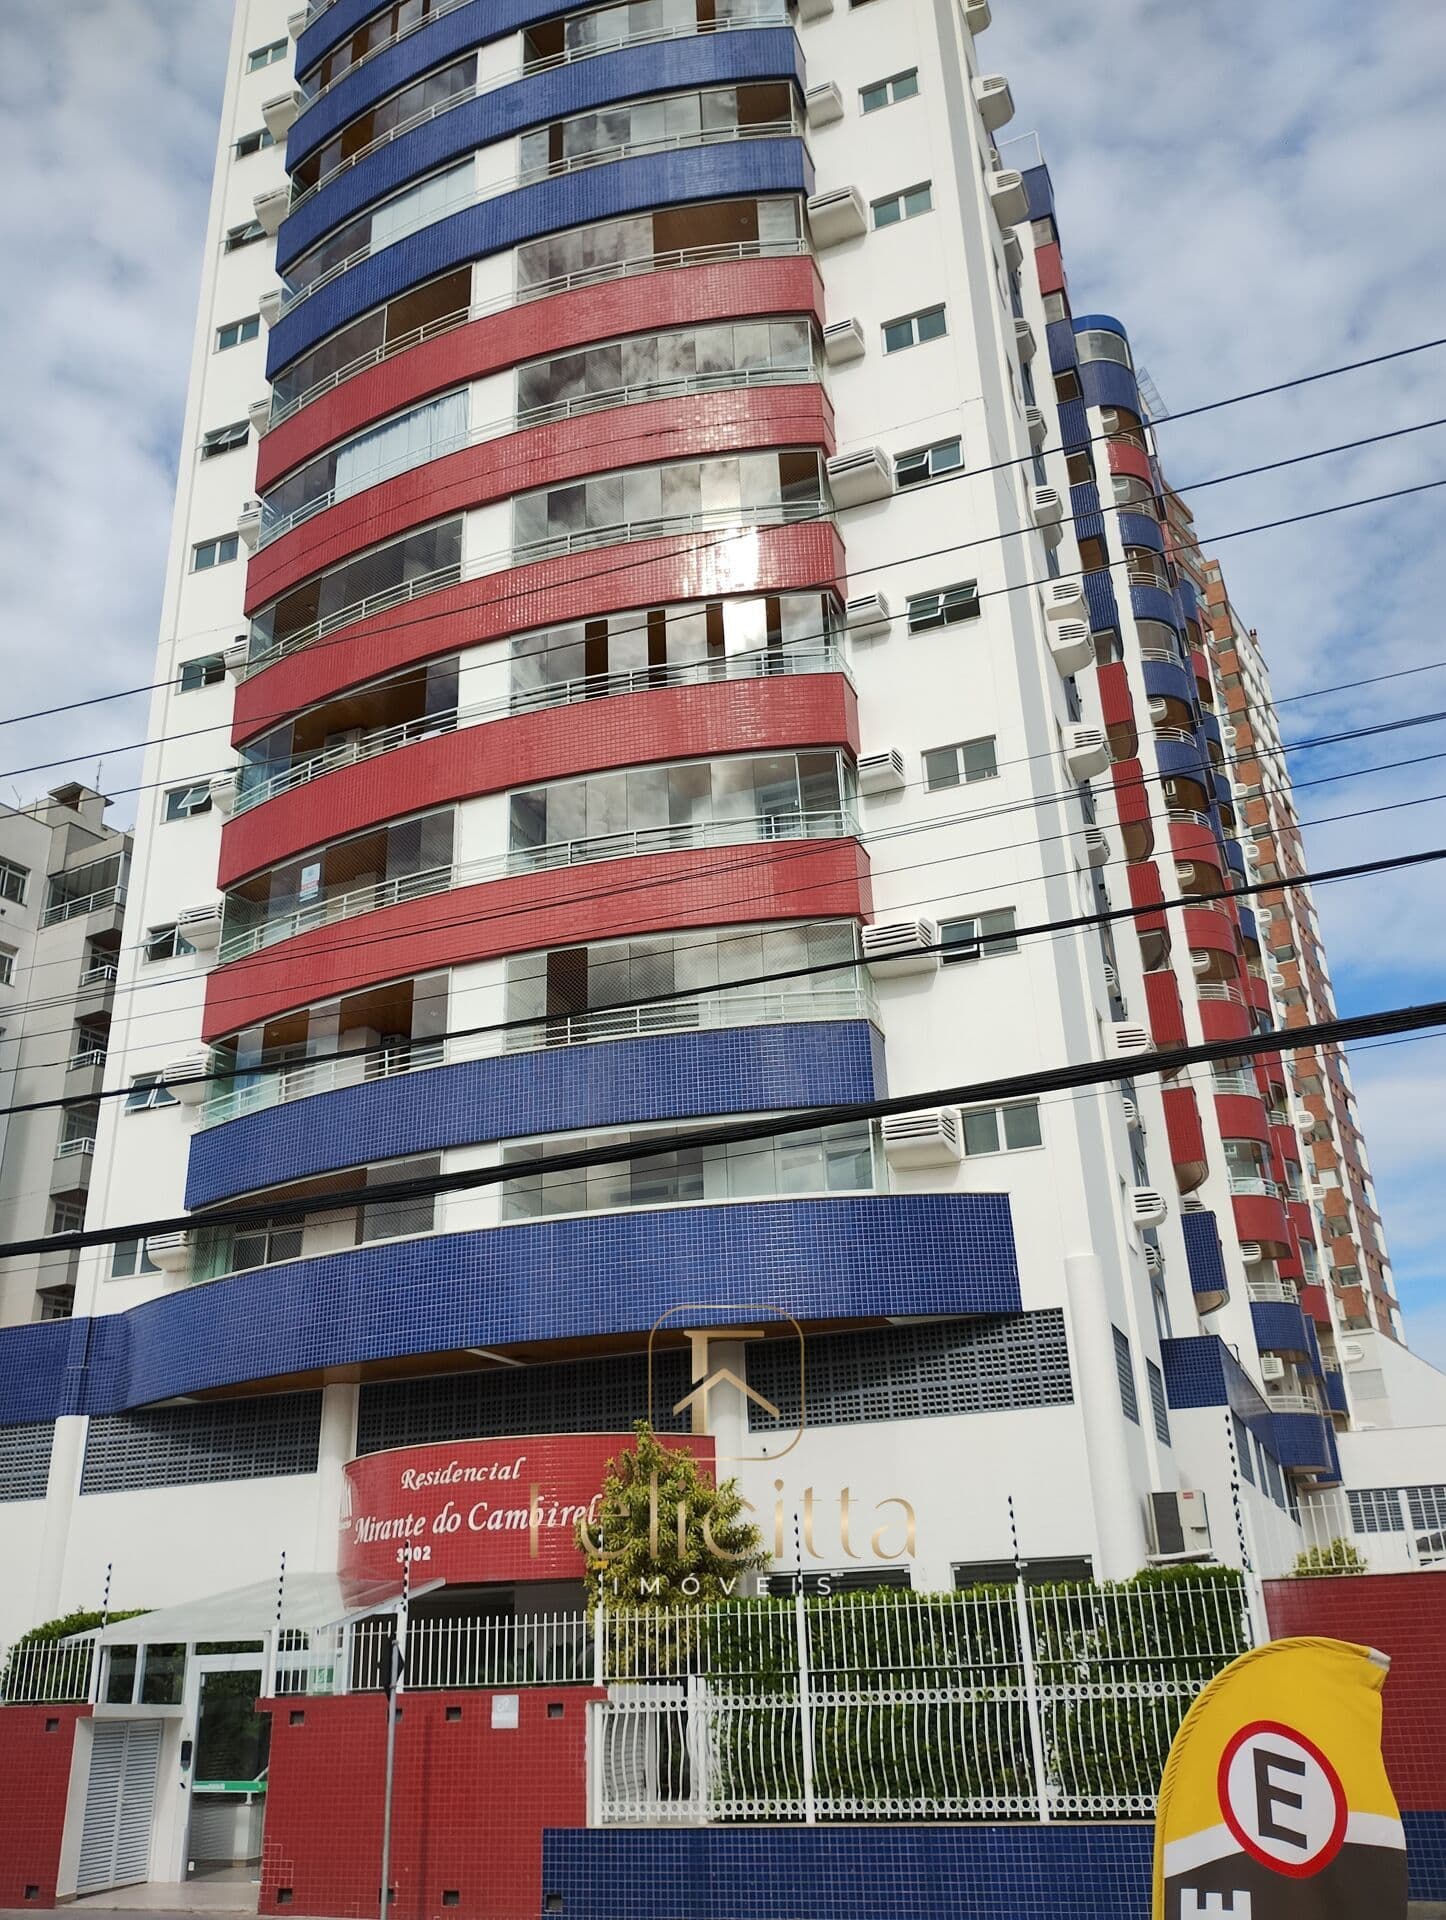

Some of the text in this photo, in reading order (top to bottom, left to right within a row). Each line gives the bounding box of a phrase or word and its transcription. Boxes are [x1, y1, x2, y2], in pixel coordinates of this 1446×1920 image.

[401, 1456, 526, 1491] Residencial
[353, 1513, 426, 1545] Mirante
[432, 1500, 462, 1535] do
[1252, 1747, 1307, 1850] E
